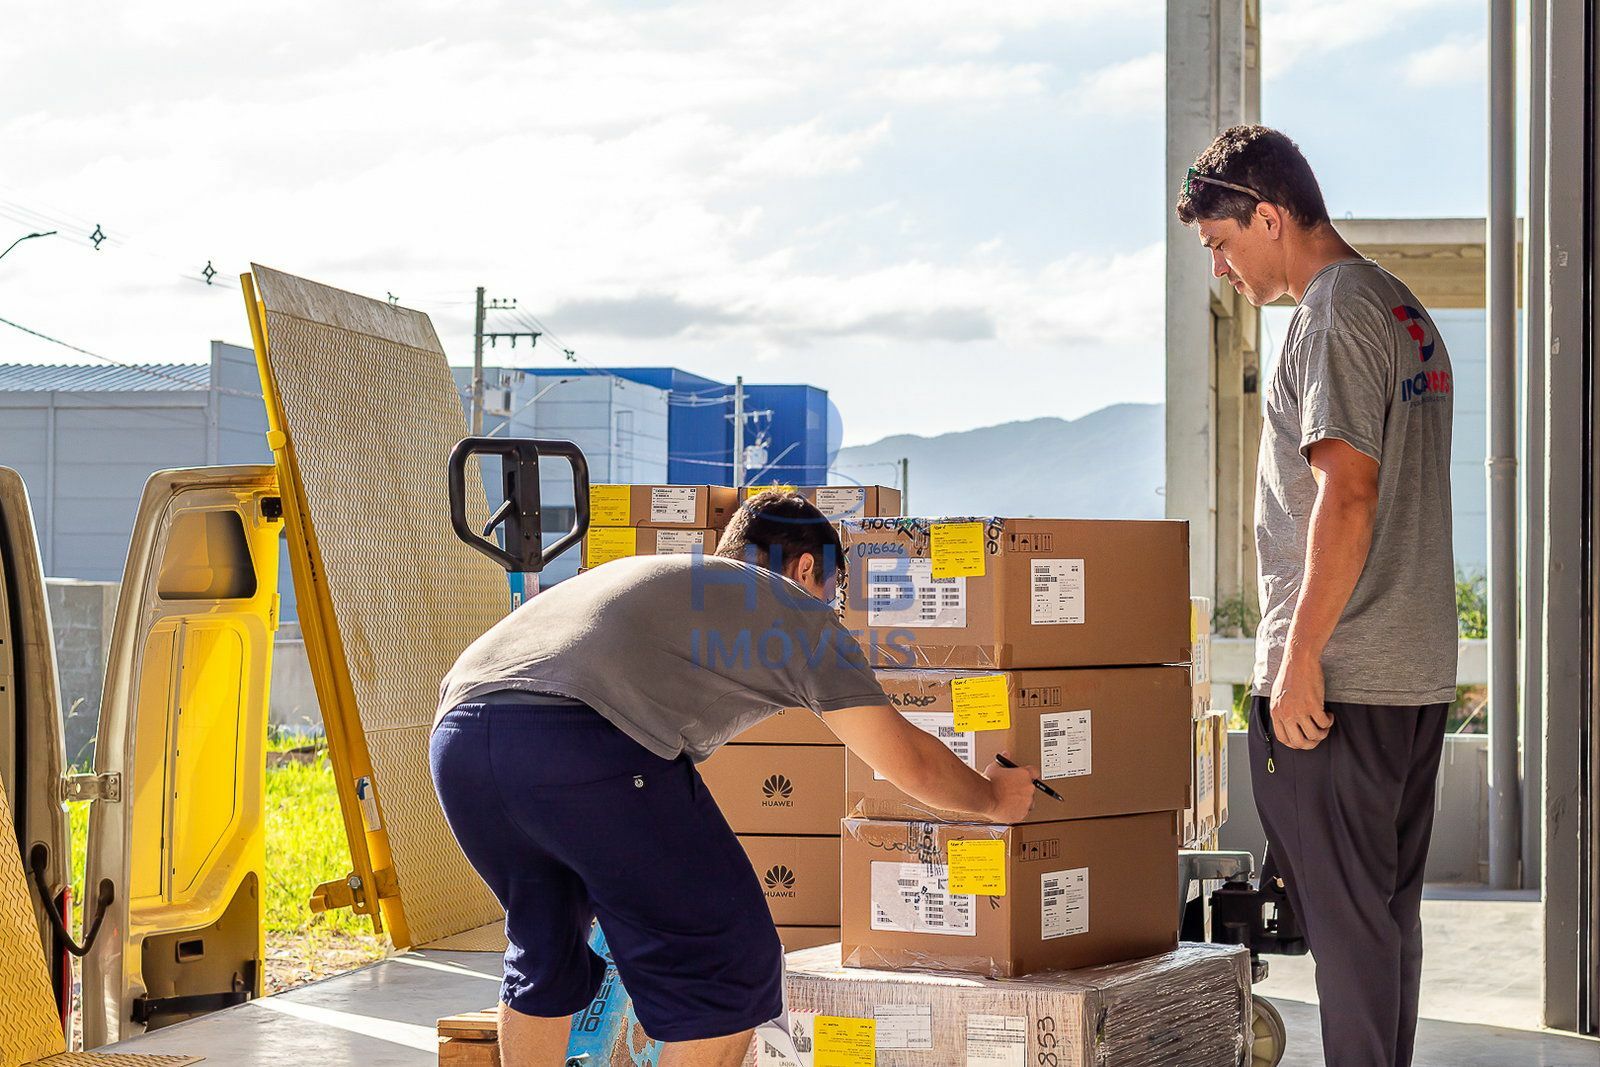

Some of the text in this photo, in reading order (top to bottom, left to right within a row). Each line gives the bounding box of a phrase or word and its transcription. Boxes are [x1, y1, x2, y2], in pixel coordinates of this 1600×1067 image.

[857, 541, 905, 558] 036626
[763, 890, 796, 898] HUAWEI
[1037, 1016, 1058, 1067] 853
